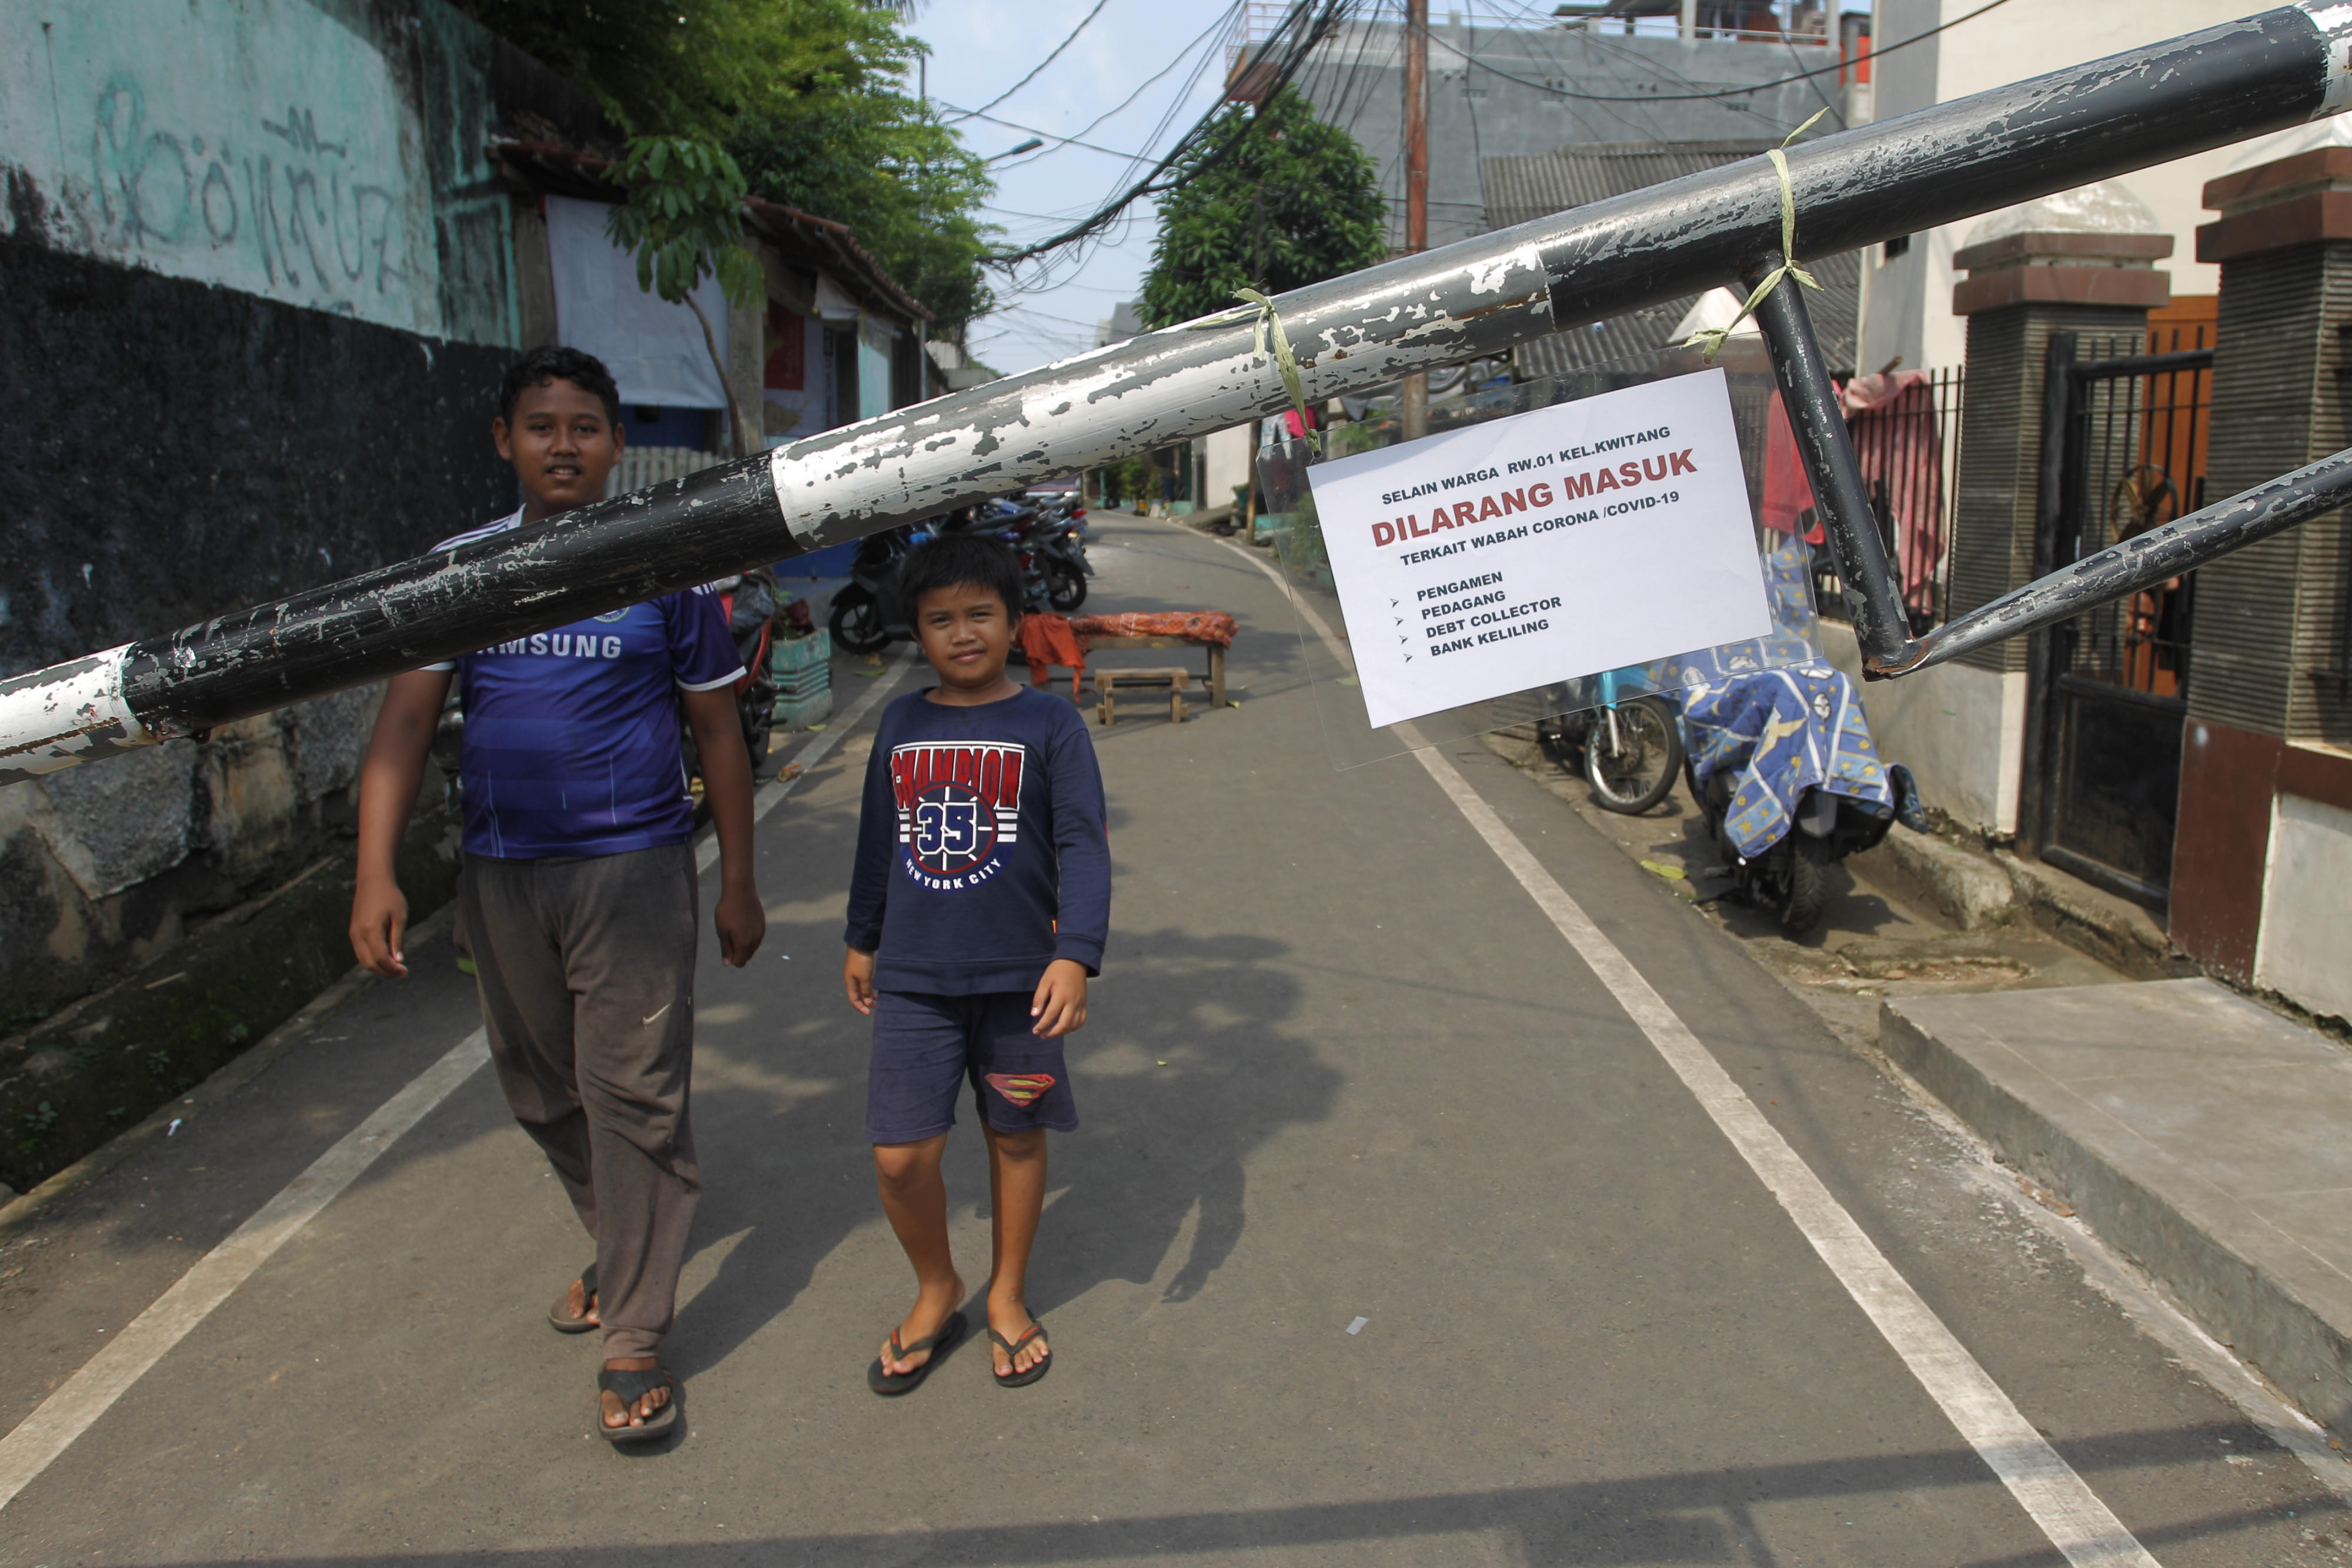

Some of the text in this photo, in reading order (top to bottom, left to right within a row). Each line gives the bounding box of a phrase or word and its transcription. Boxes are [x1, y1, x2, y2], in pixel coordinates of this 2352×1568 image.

[1382, 426, 1671, 504] SELAIN WARGA RW.01 KEL.KWITANG
[1371, 448, 1698, 547] DILARANG MASUK
[1400, 491, 1679, 565] TERKAIT WABAH CORONA /COVID-19
[1417, 571, 1503, 601] PENGAMEN
[1421, 590, 1506, 620] PEDAGANG
[1426, 597, 1562, 638] DEBT COLLECTOR
[1431, 619, 1549, 656] BANK KELILING
[890, 745, 1024, 812] CHAMPION
[917, 803, 977, 855] 35
[906, 858, 1001, 890] NEW YORK CITY
